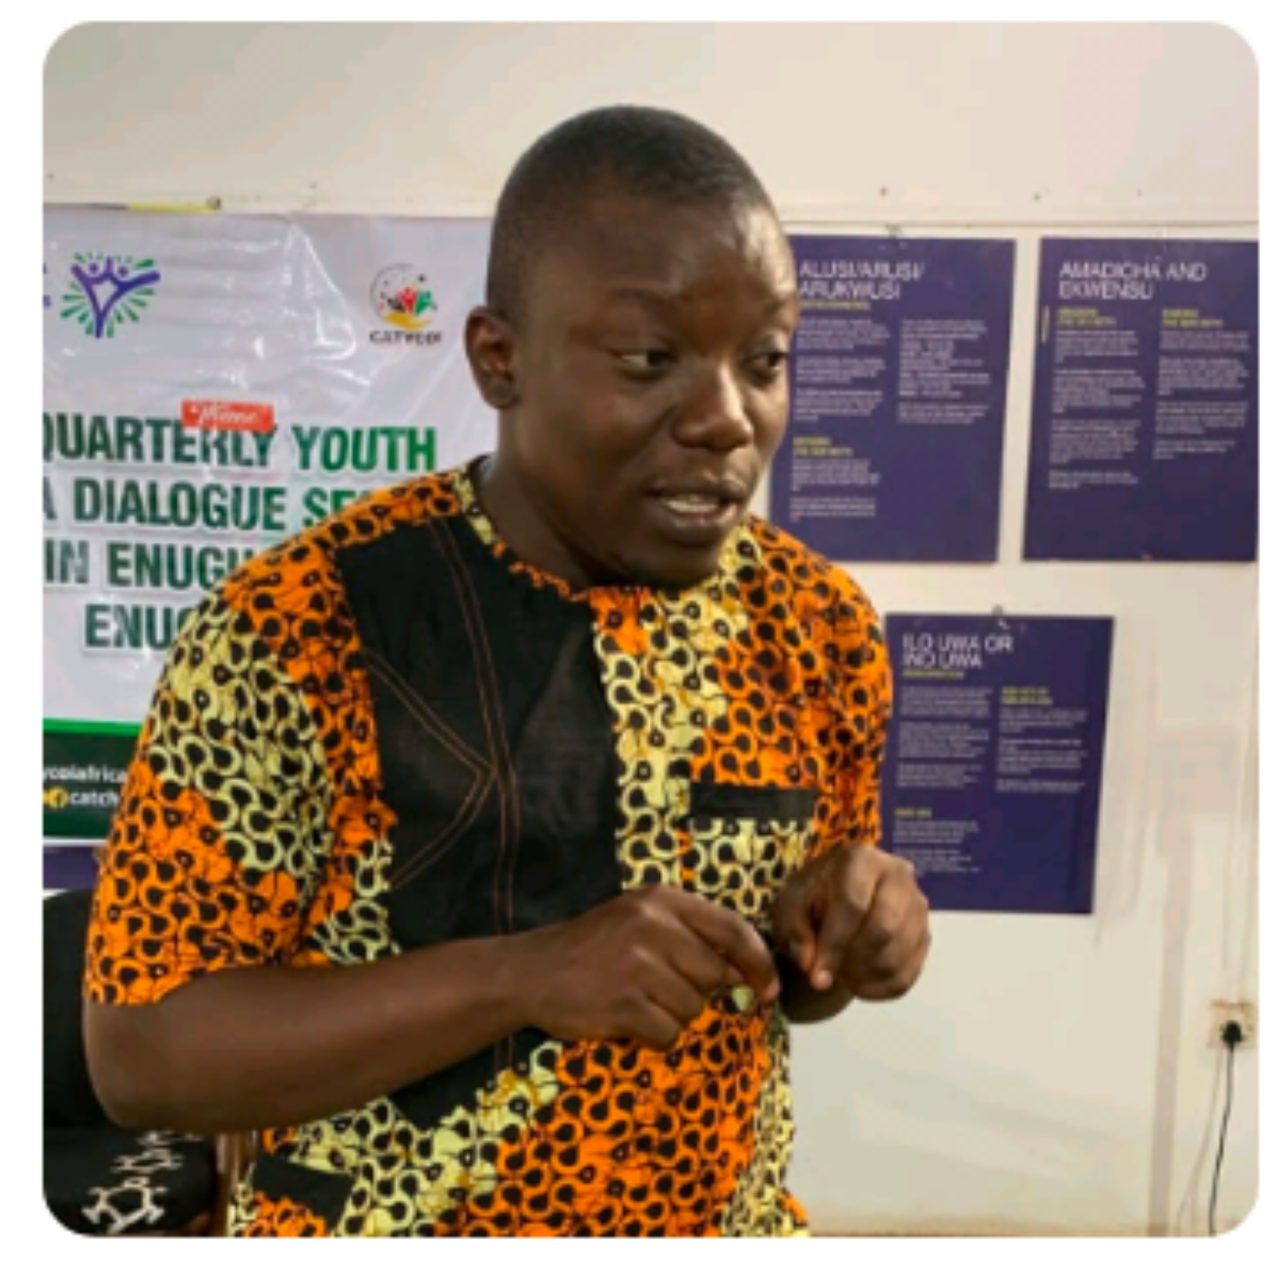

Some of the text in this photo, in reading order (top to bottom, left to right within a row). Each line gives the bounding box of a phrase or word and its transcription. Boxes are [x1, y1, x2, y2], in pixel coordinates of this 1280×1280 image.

[292, 425, 437, 472] YOUTH
[74, 478, 286, 531] DIALOGUE
[44, 540, 90, 584] IN
